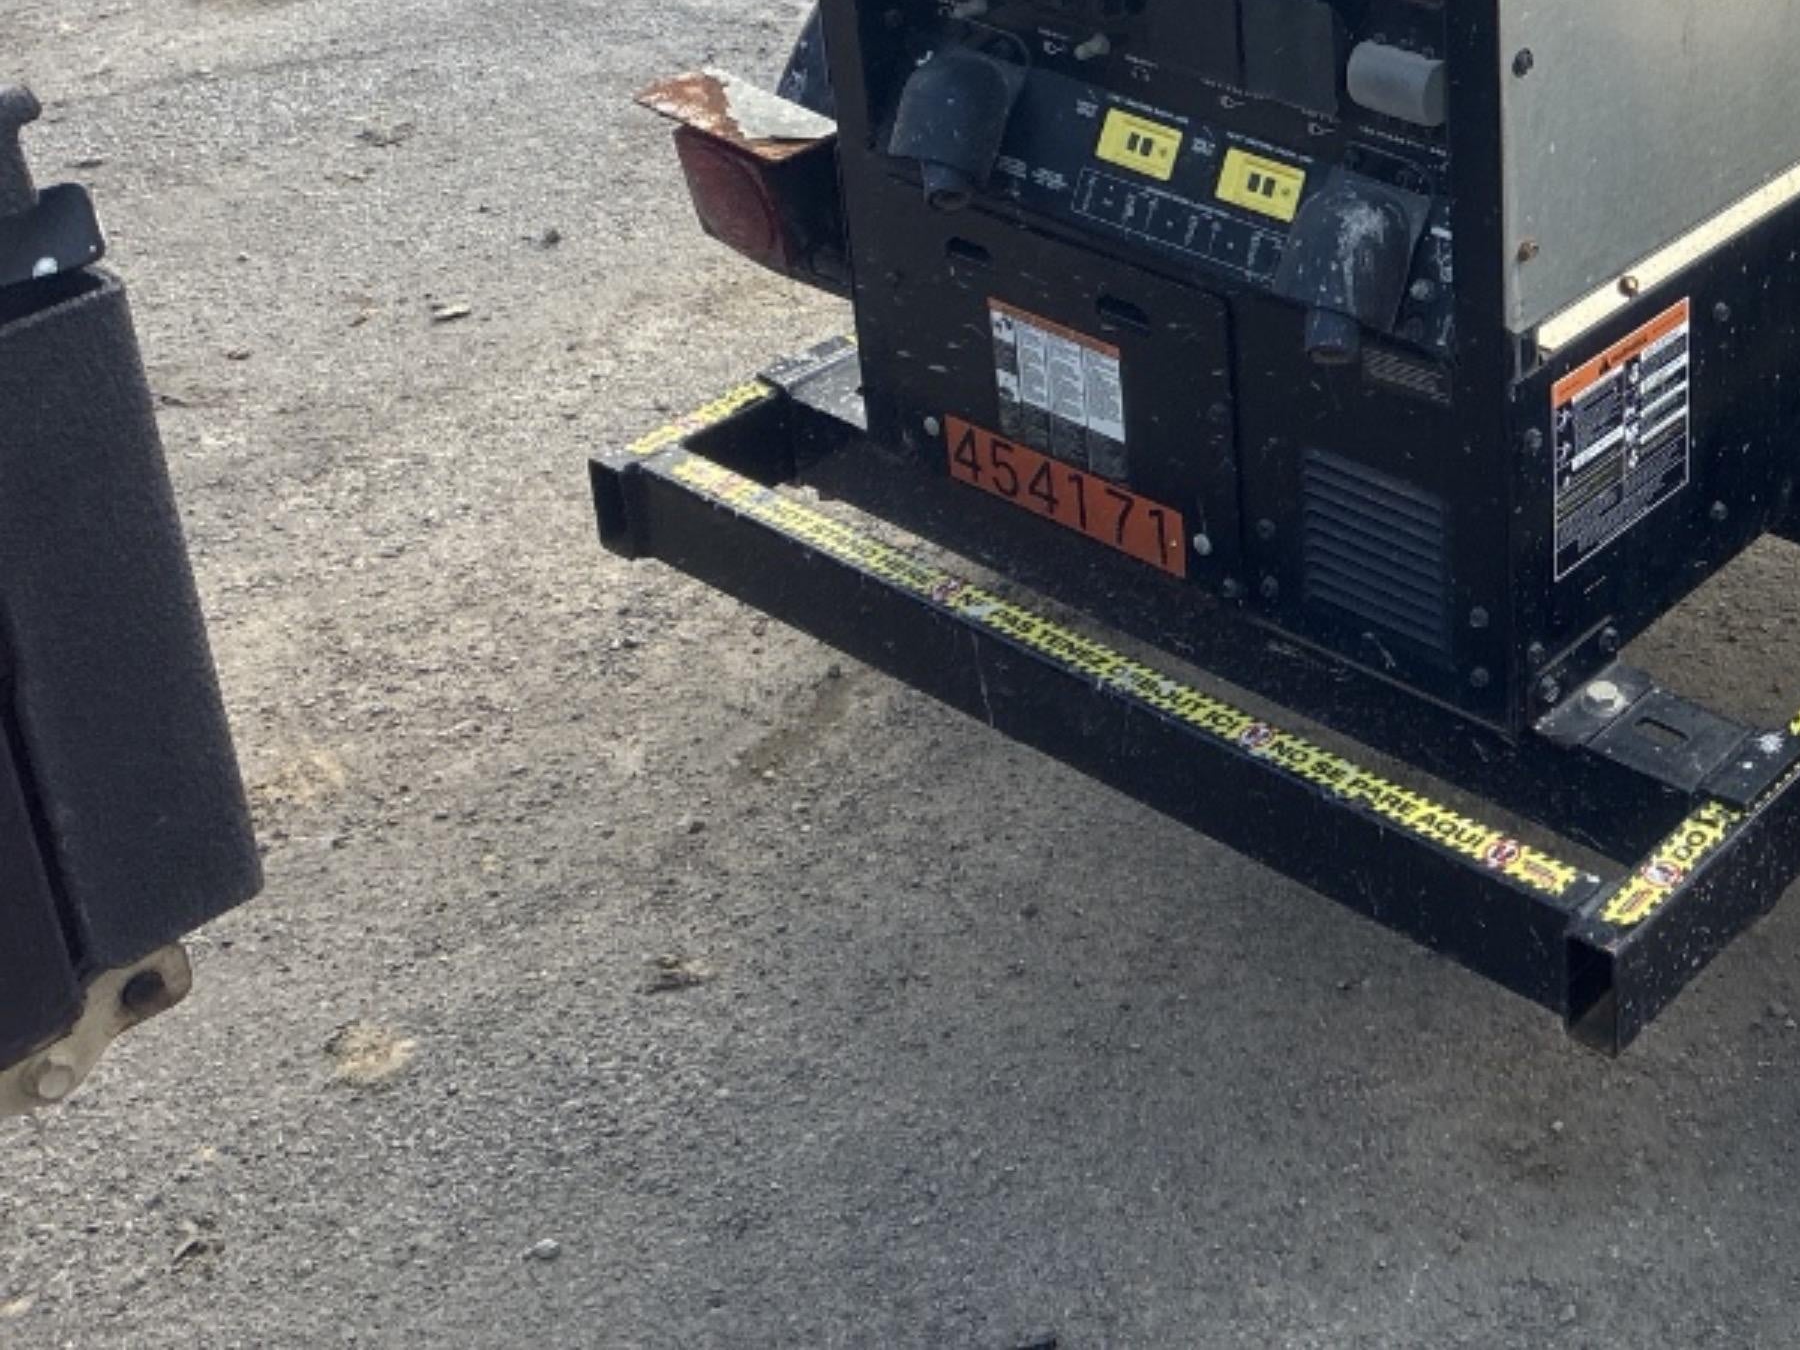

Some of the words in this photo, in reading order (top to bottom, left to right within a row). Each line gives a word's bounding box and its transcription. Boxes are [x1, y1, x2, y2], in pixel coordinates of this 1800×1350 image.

[953, 427, 1170, 566] 454171
[1268, 739, 1310, 764] NO
[1347, 776, 1420, 817] PARE
[1416, 809, 1485, 848] AQUI
[1671, 827, 1707, 861] DO
